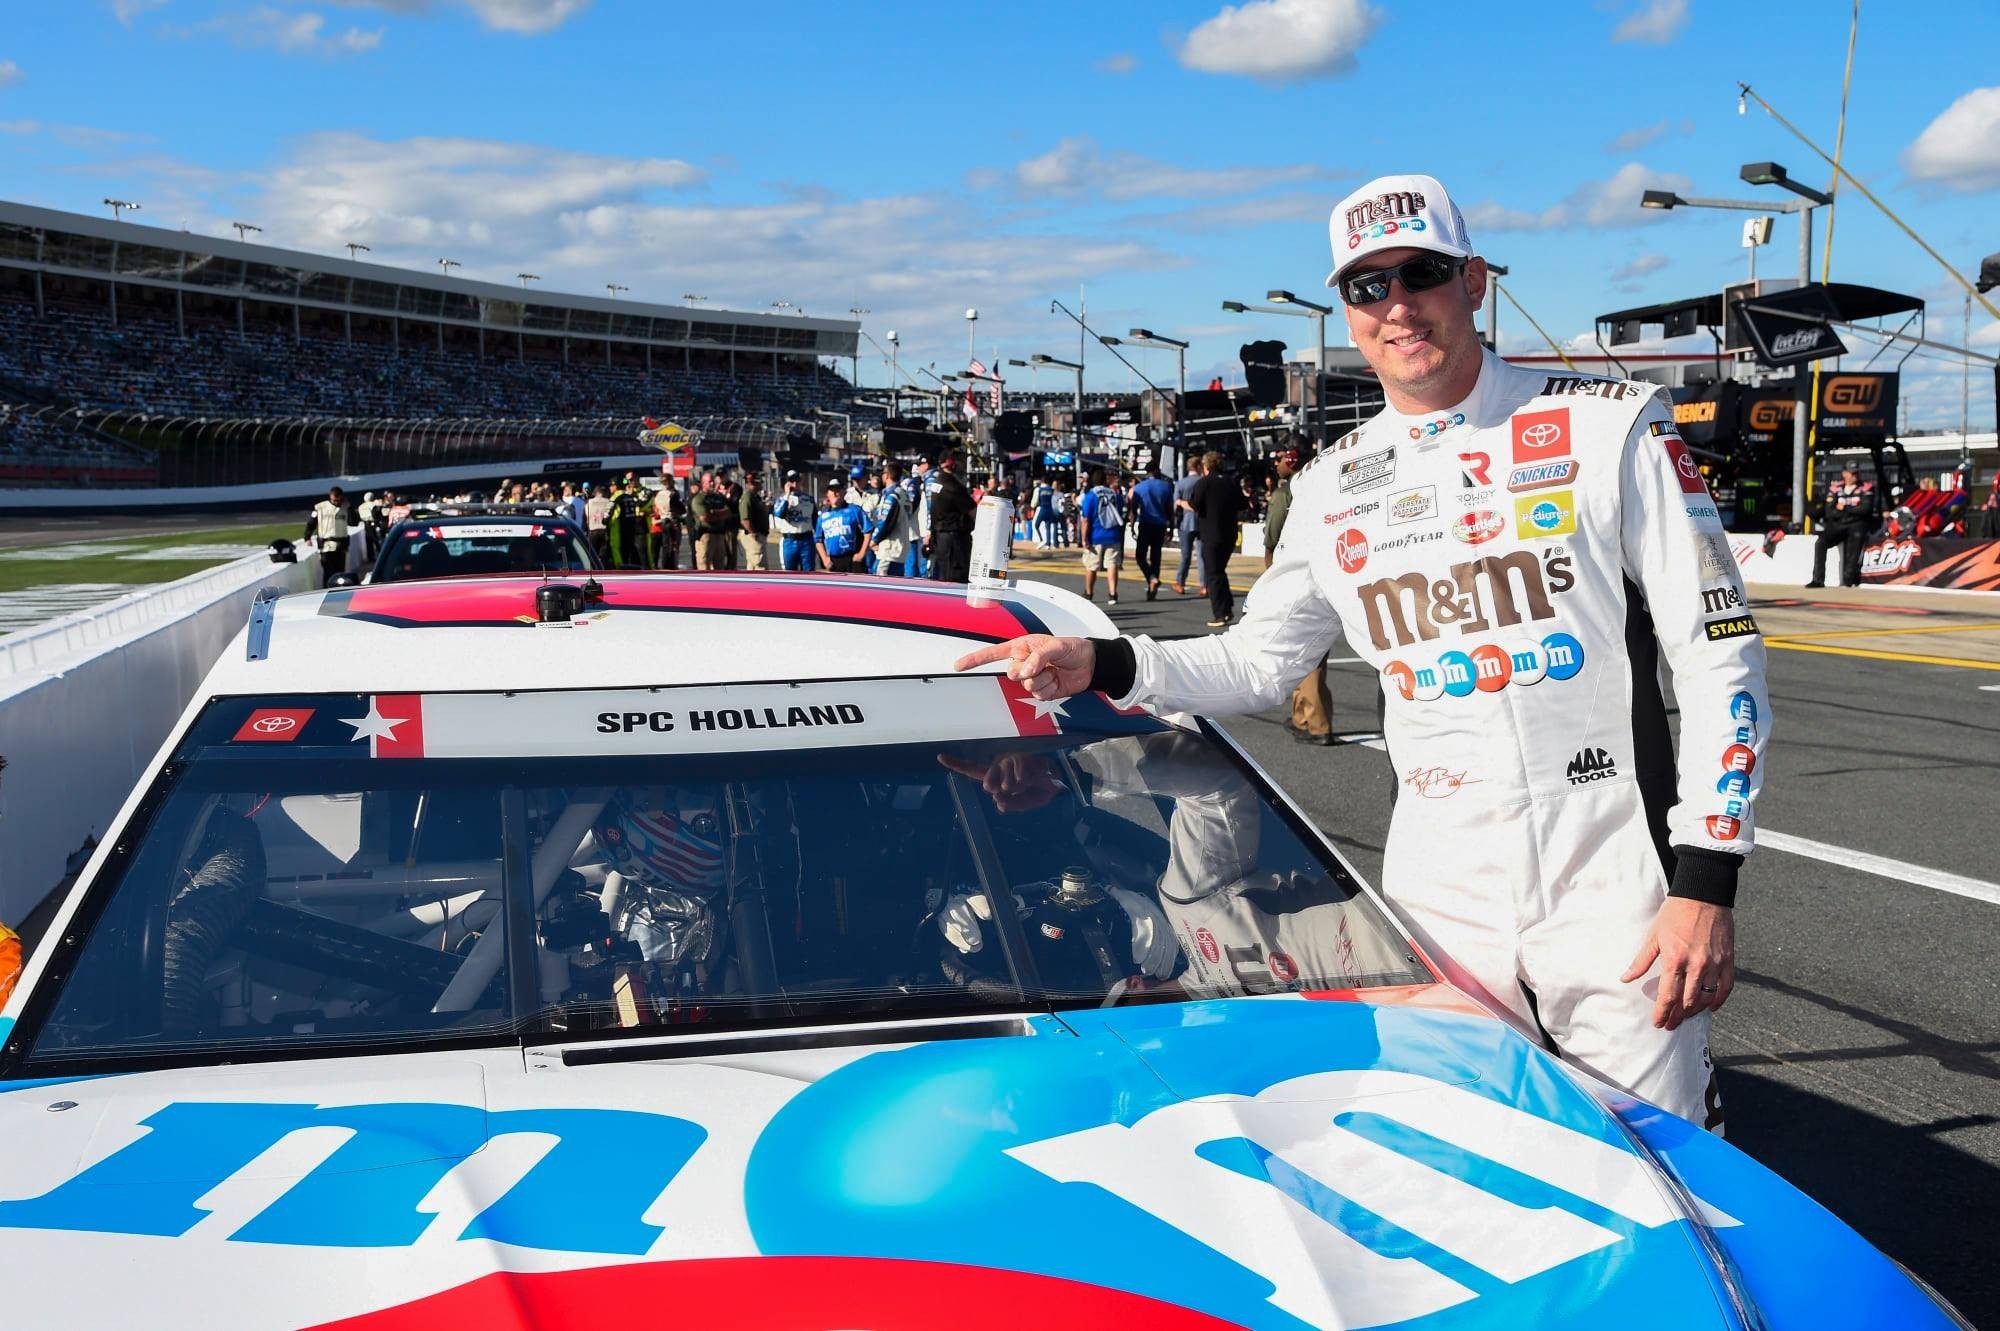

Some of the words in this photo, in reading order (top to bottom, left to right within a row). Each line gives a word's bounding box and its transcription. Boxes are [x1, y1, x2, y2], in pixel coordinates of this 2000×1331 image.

[646, 433, 698, 444] SUNOCO
[1361, 463, 1387, 479] SERIES
[1511, 463, 1570, 485] SNICKERS
[1324, 500, 1381, 525] SportClips
[1337, 529, 1369, 568] Rheem
[1709, 619, 1757, 637] STANL
[596, 710, 674, 733] SPC
[688, 703, 866, 732] HOLLAND
[1566, 747, 1615, 777] MAC
[1567, 768, 1618, 786] TOOLS
